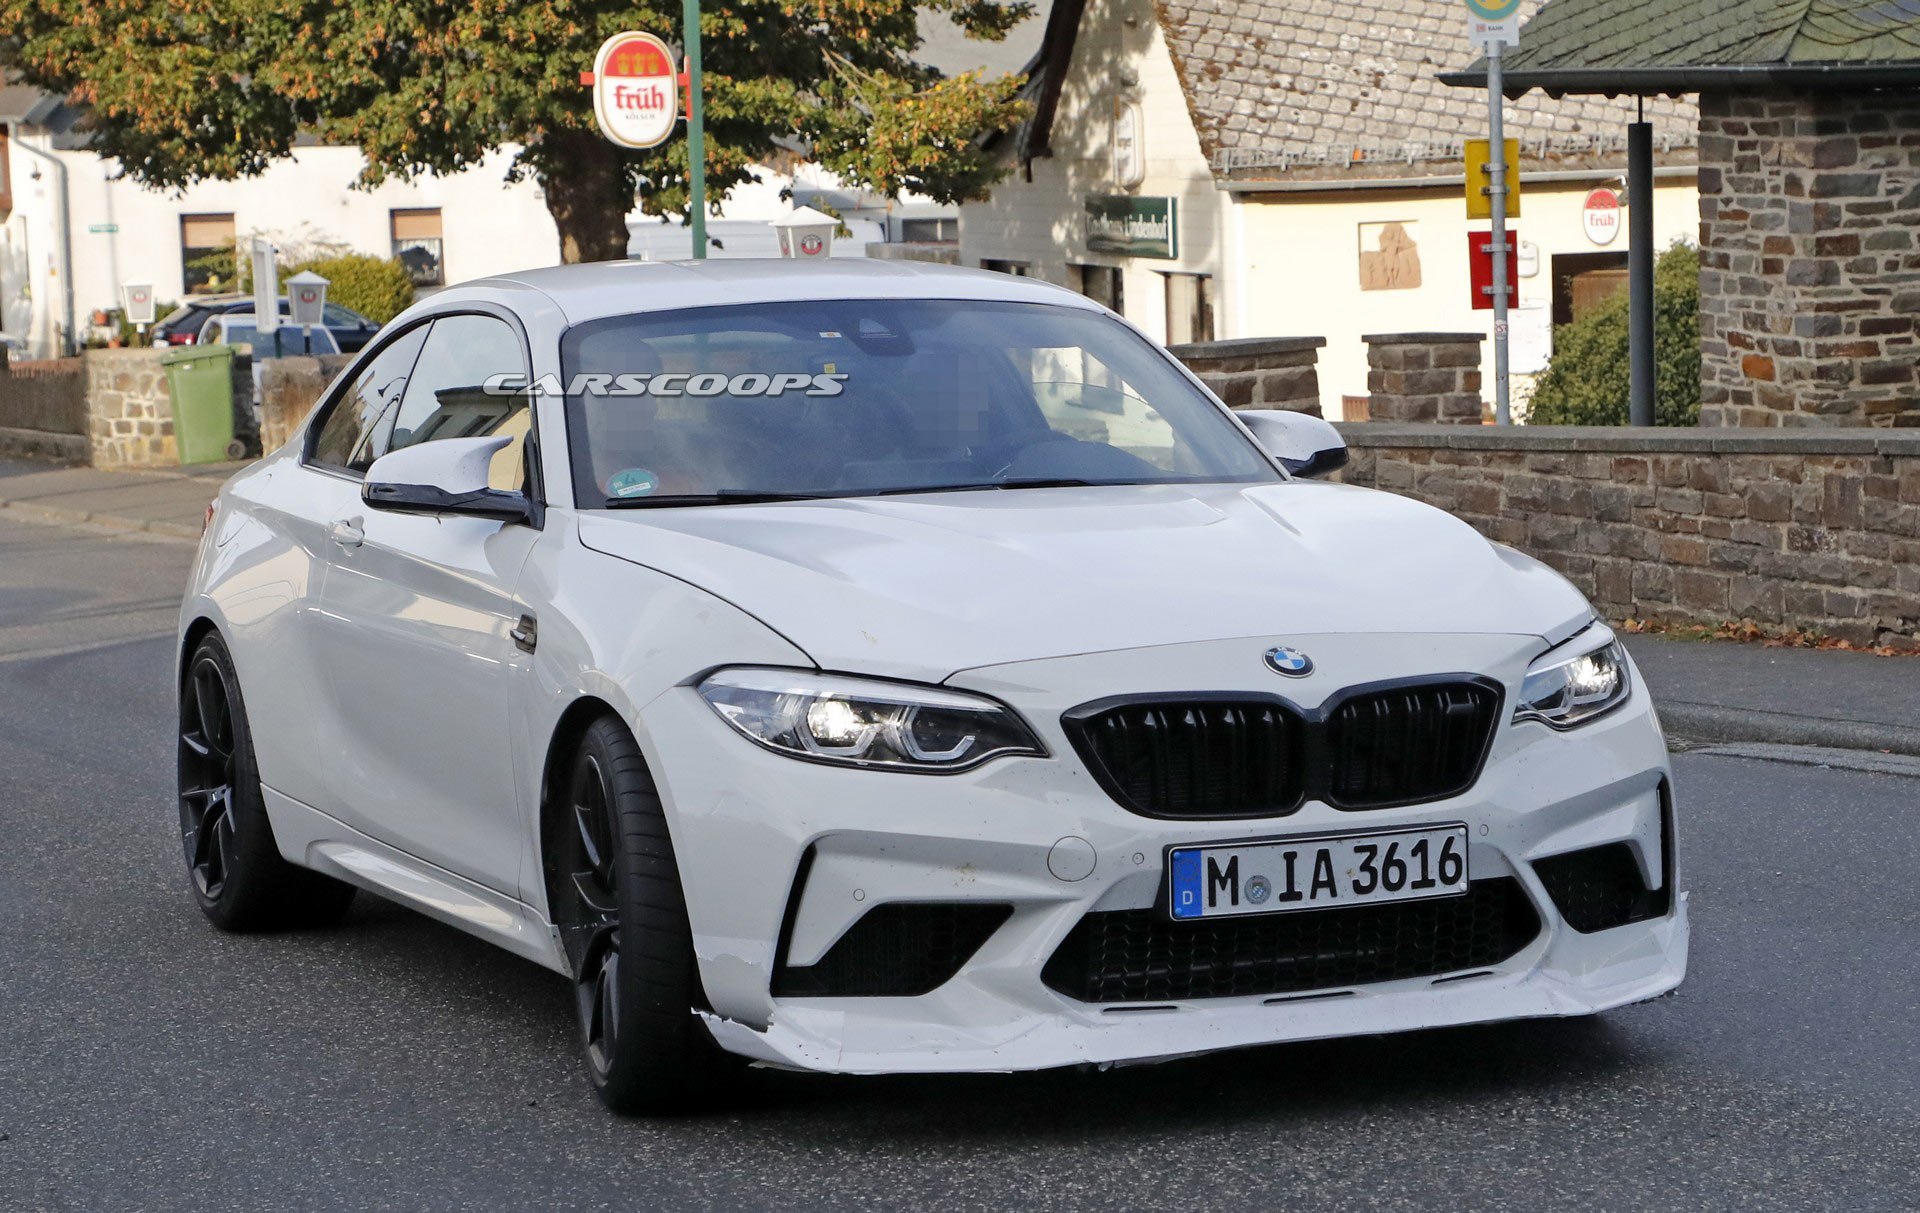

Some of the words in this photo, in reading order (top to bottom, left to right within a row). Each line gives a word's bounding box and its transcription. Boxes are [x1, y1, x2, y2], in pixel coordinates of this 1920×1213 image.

[613, 84, 665, 111] früh
[1124, 213, 1168, 240] Lindenhof
[1207, 855, 1239, 907] M
[1279, 848, 1338, 902] IA
[1352, 836, 1463, 895] 3616
[1182, 891, 1193, 905] D
